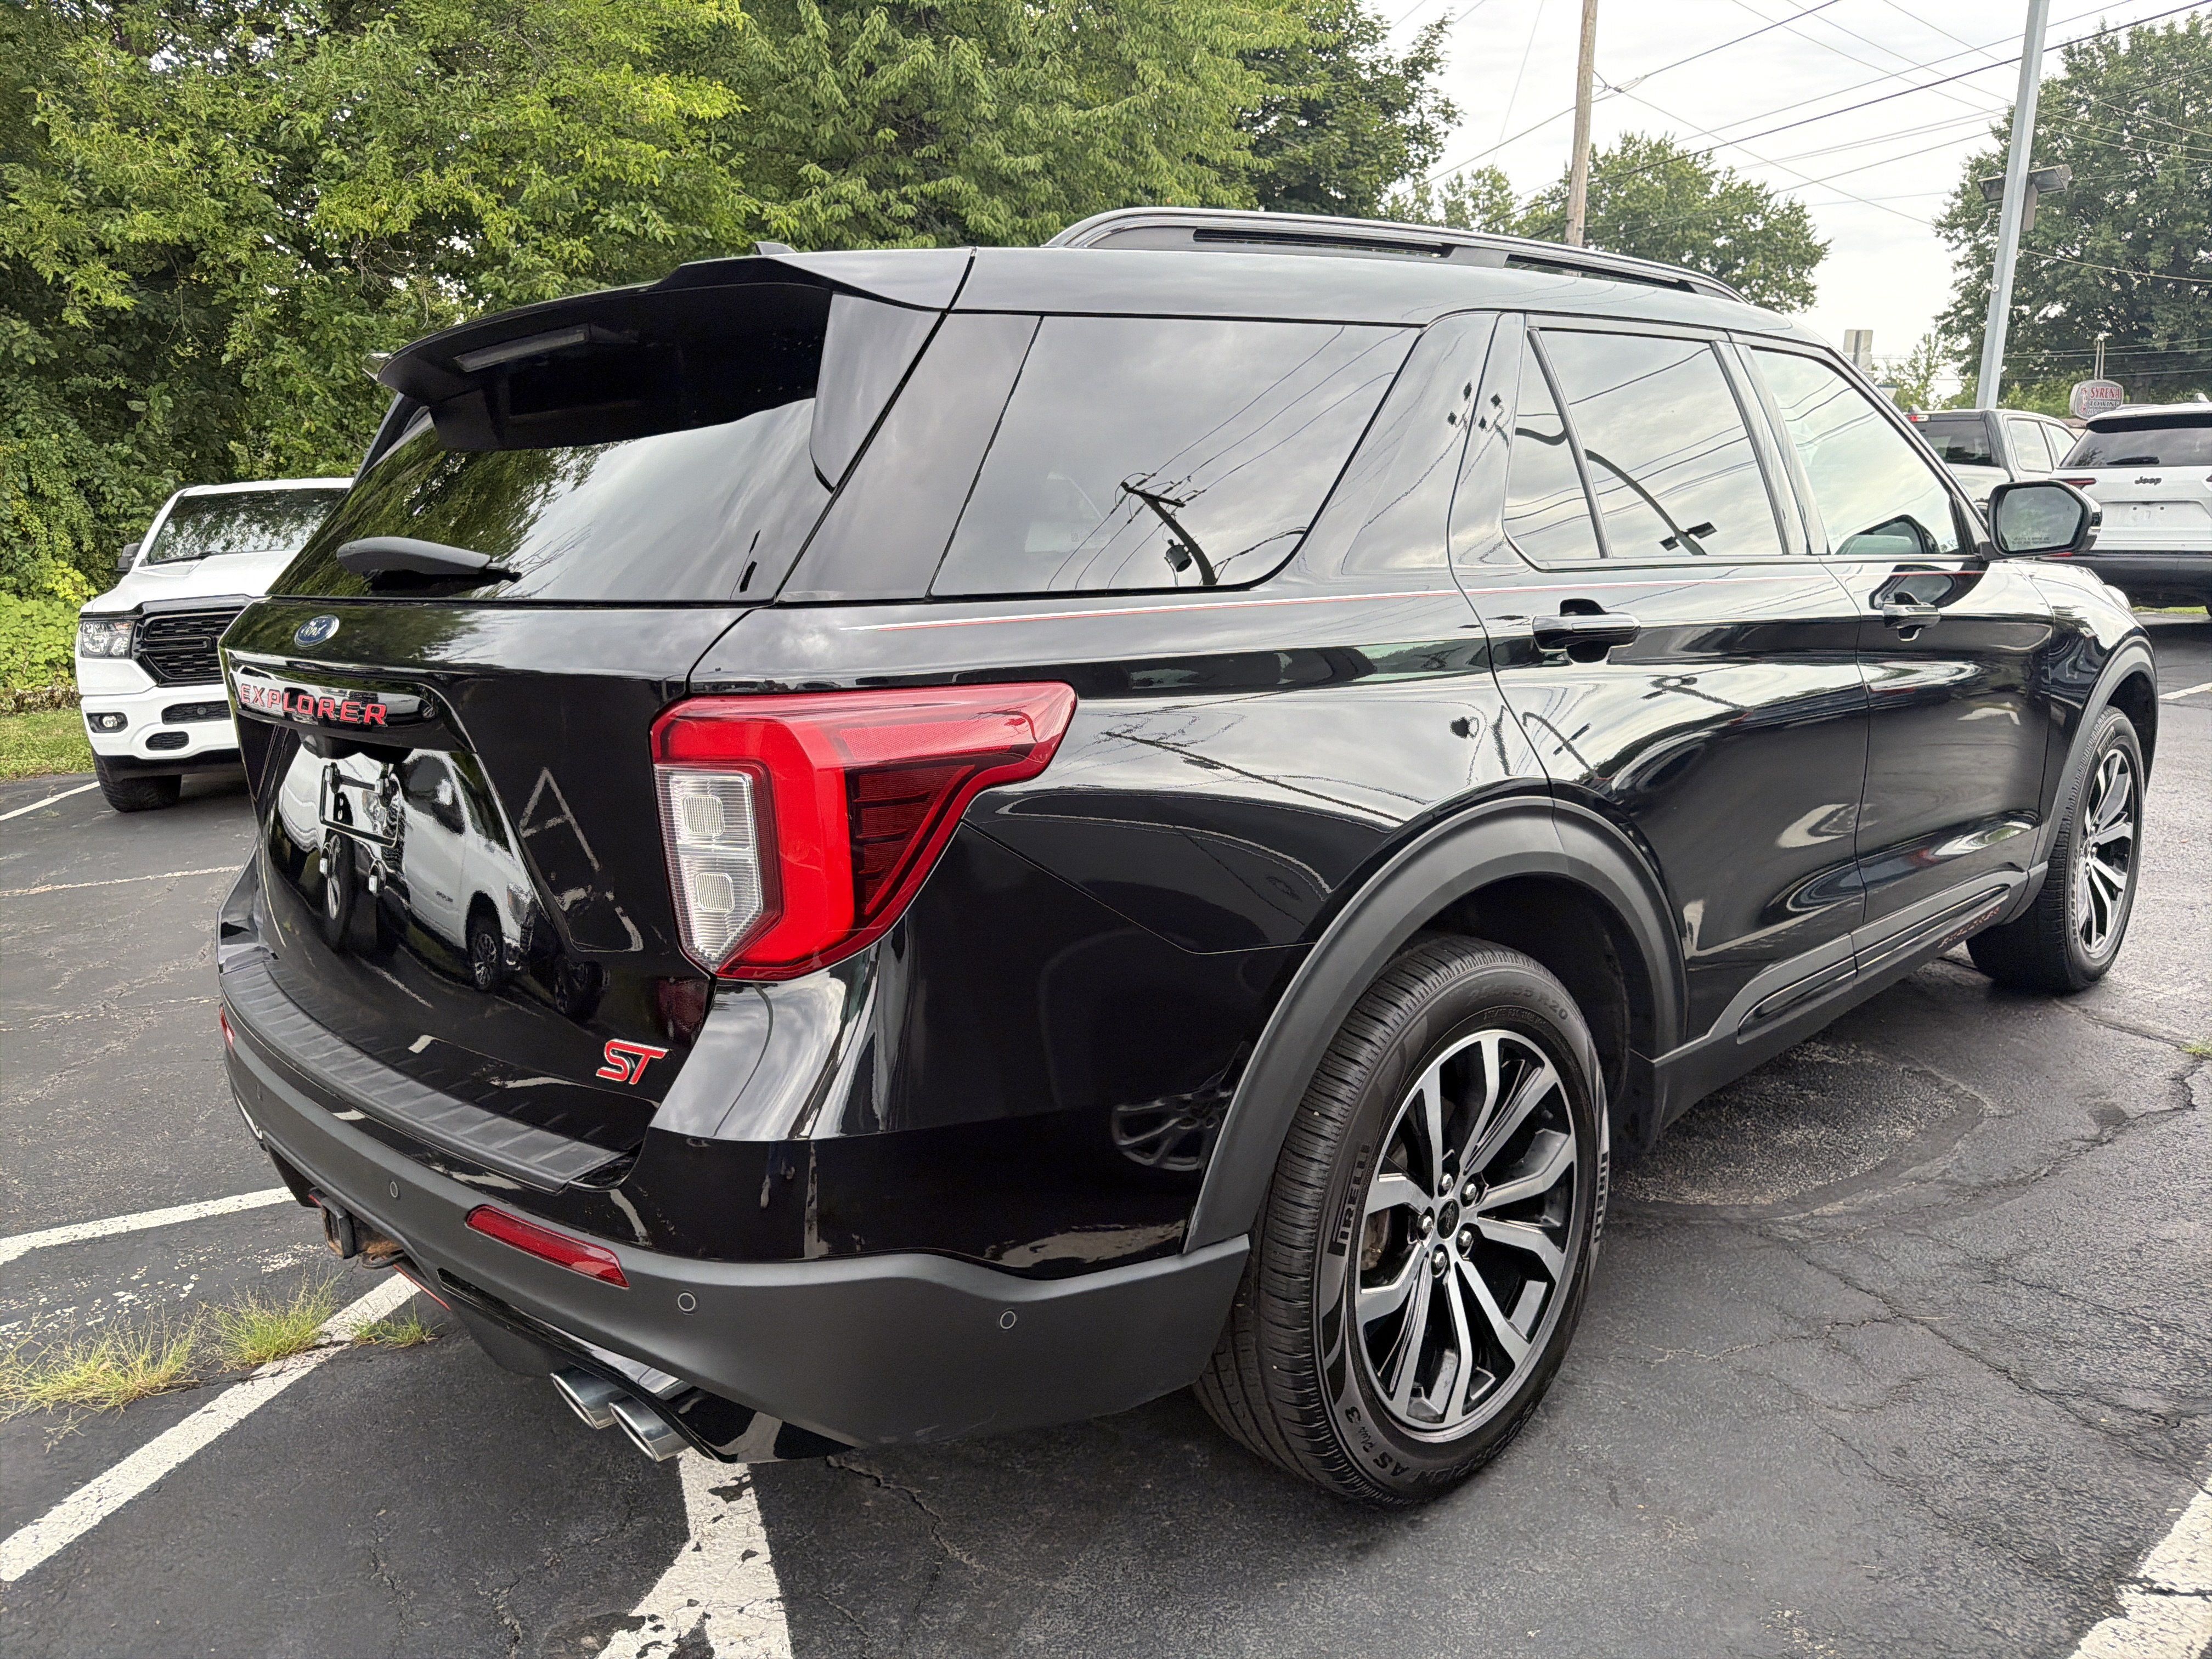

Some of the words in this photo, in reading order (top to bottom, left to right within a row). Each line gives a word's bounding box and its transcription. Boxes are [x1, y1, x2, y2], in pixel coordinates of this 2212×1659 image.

[2089, 400, 2120, 408] TOWING
[2090, 386, 2121, 400] SYRENA
[2134, 476, 2162, 486] Jeep
[240, 684, 387, 727] EXPLORER
[596, 1038, 669, 1085] ST
[1327, 1144, 1370, 1256] PIRELLI
